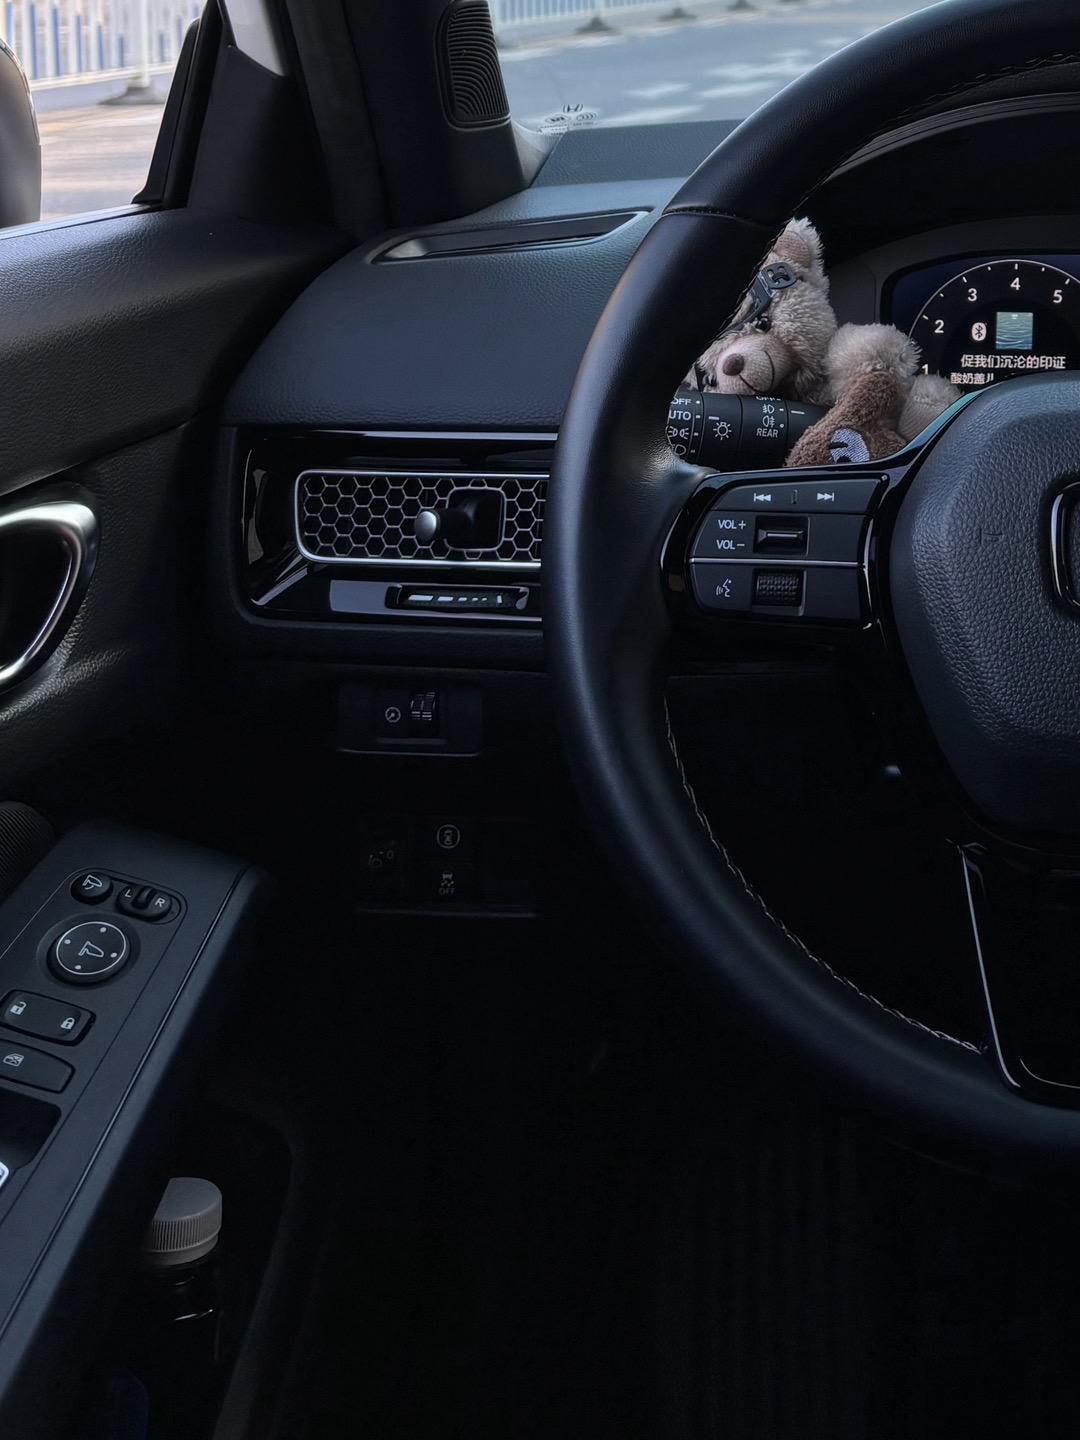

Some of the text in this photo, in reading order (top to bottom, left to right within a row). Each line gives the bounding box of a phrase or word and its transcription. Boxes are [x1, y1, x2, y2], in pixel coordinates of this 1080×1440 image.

[1010, 277, 1021, 291] 4
[967, 287, 978, 302] 3
[1053, 289, 1063, 304] 5
[934, 319, 945, 334] 2
[669, 410, 692, 420] UTO
[756, 427, 779, 438] REAR
[124, 889, 132, 898] L
[154, 897, 166, 908] R
